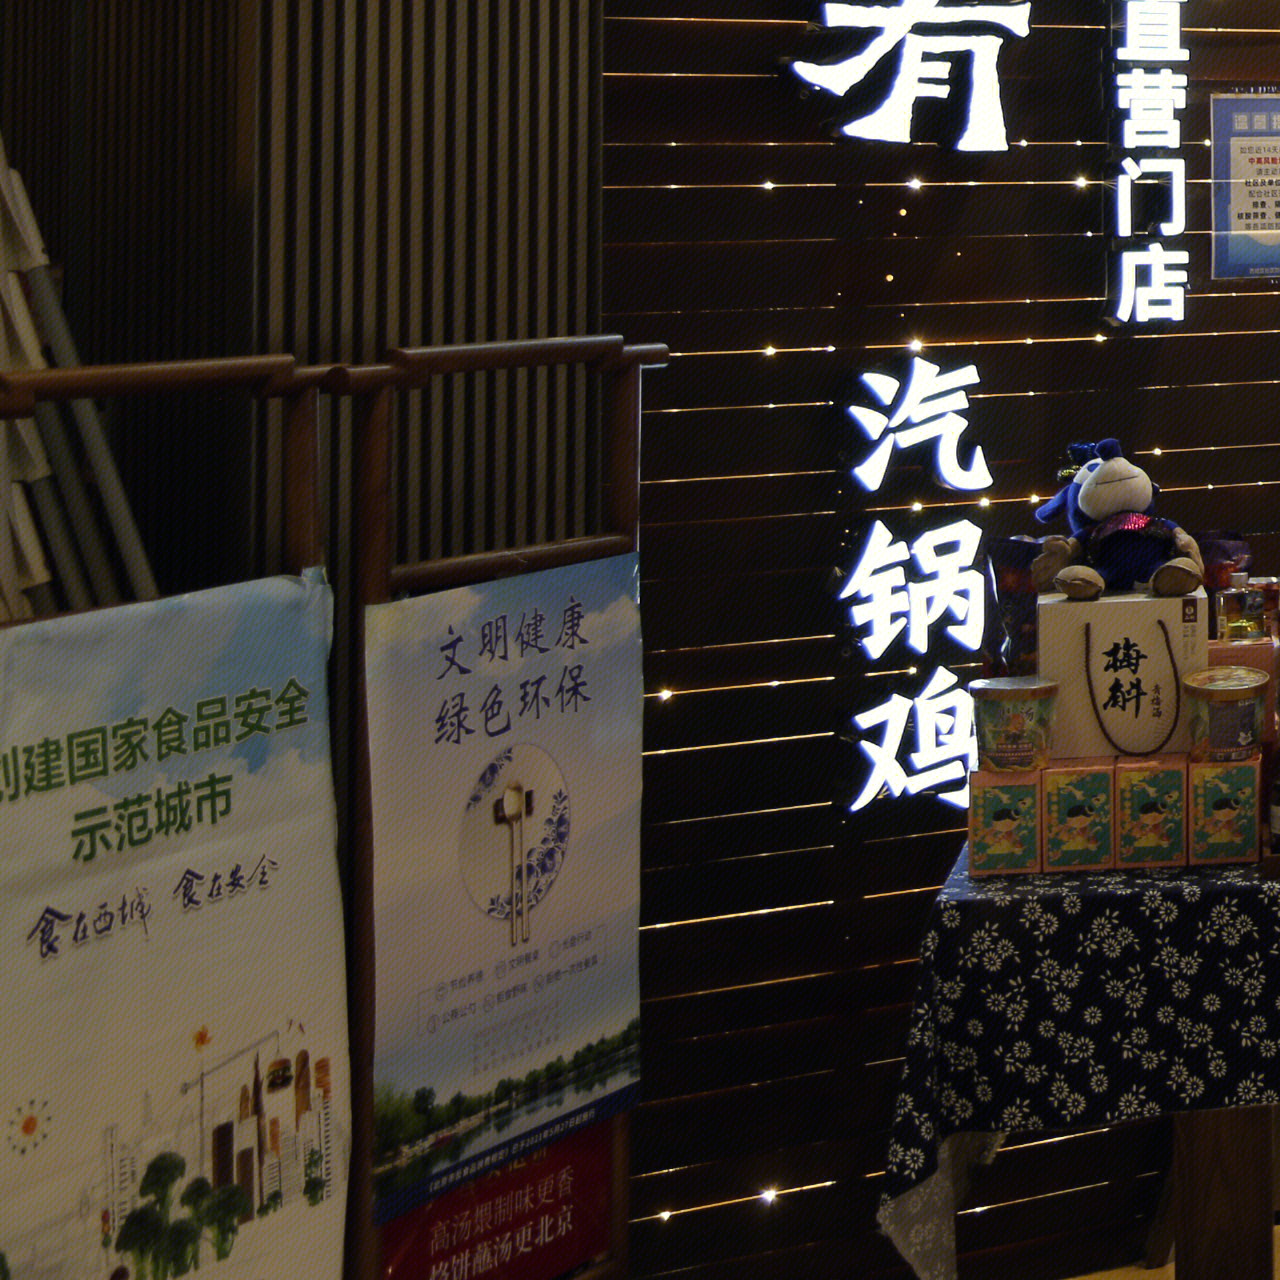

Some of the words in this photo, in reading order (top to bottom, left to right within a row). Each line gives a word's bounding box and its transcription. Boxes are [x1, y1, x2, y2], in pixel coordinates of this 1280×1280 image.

[849, 357, 994, 812] 汽锅鸡
[436, 595, 590, 680] 文明健康
[434, 664, 592, 745] 绿色环保
[71, 773, 233, 862] 示范城市
